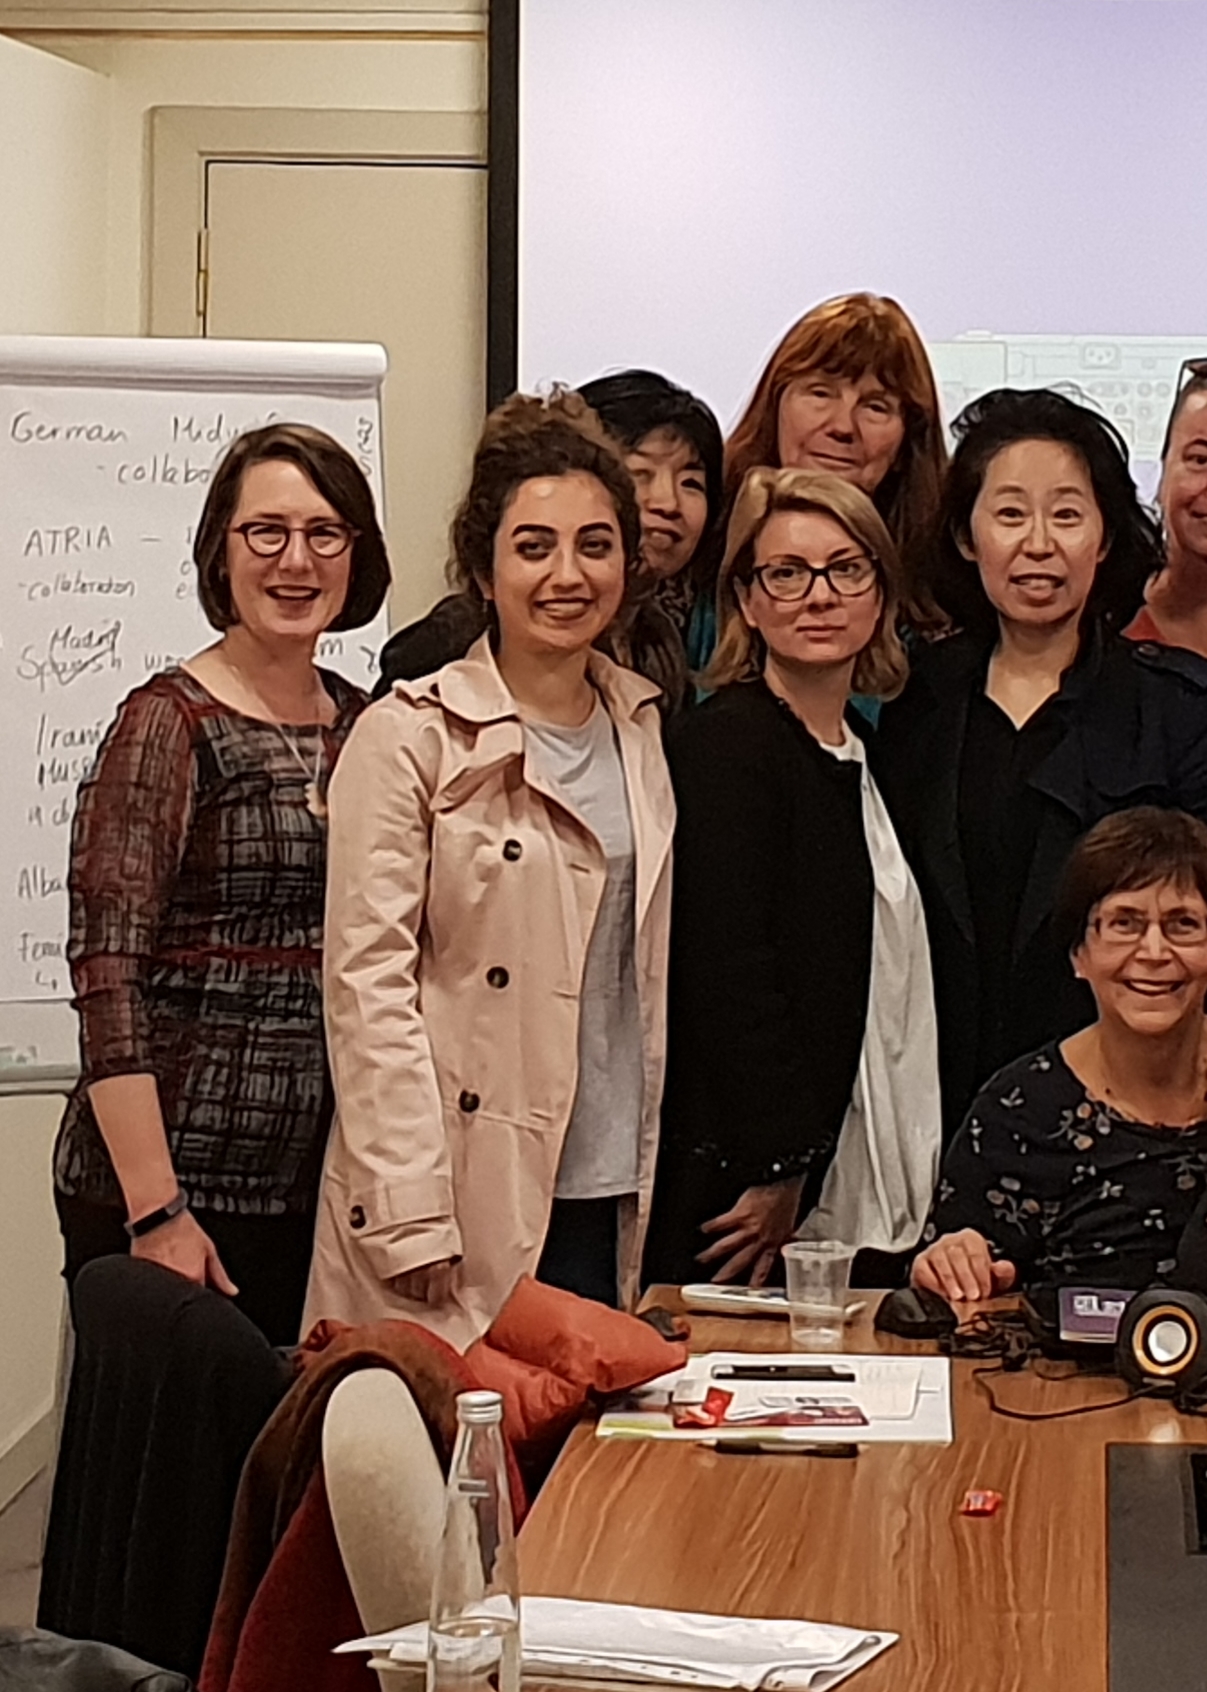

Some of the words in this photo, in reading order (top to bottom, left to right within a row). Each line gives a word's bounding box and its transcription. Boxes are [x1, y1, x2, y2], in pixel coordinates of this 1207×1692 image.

[11, 411, 128, 443] German
[24, 525, 112, 557] ATRIA
[37, 713, 103, 756] Irani
[18, 864, 64, 899] Alba
[18, 932, 64, 962] Femi
